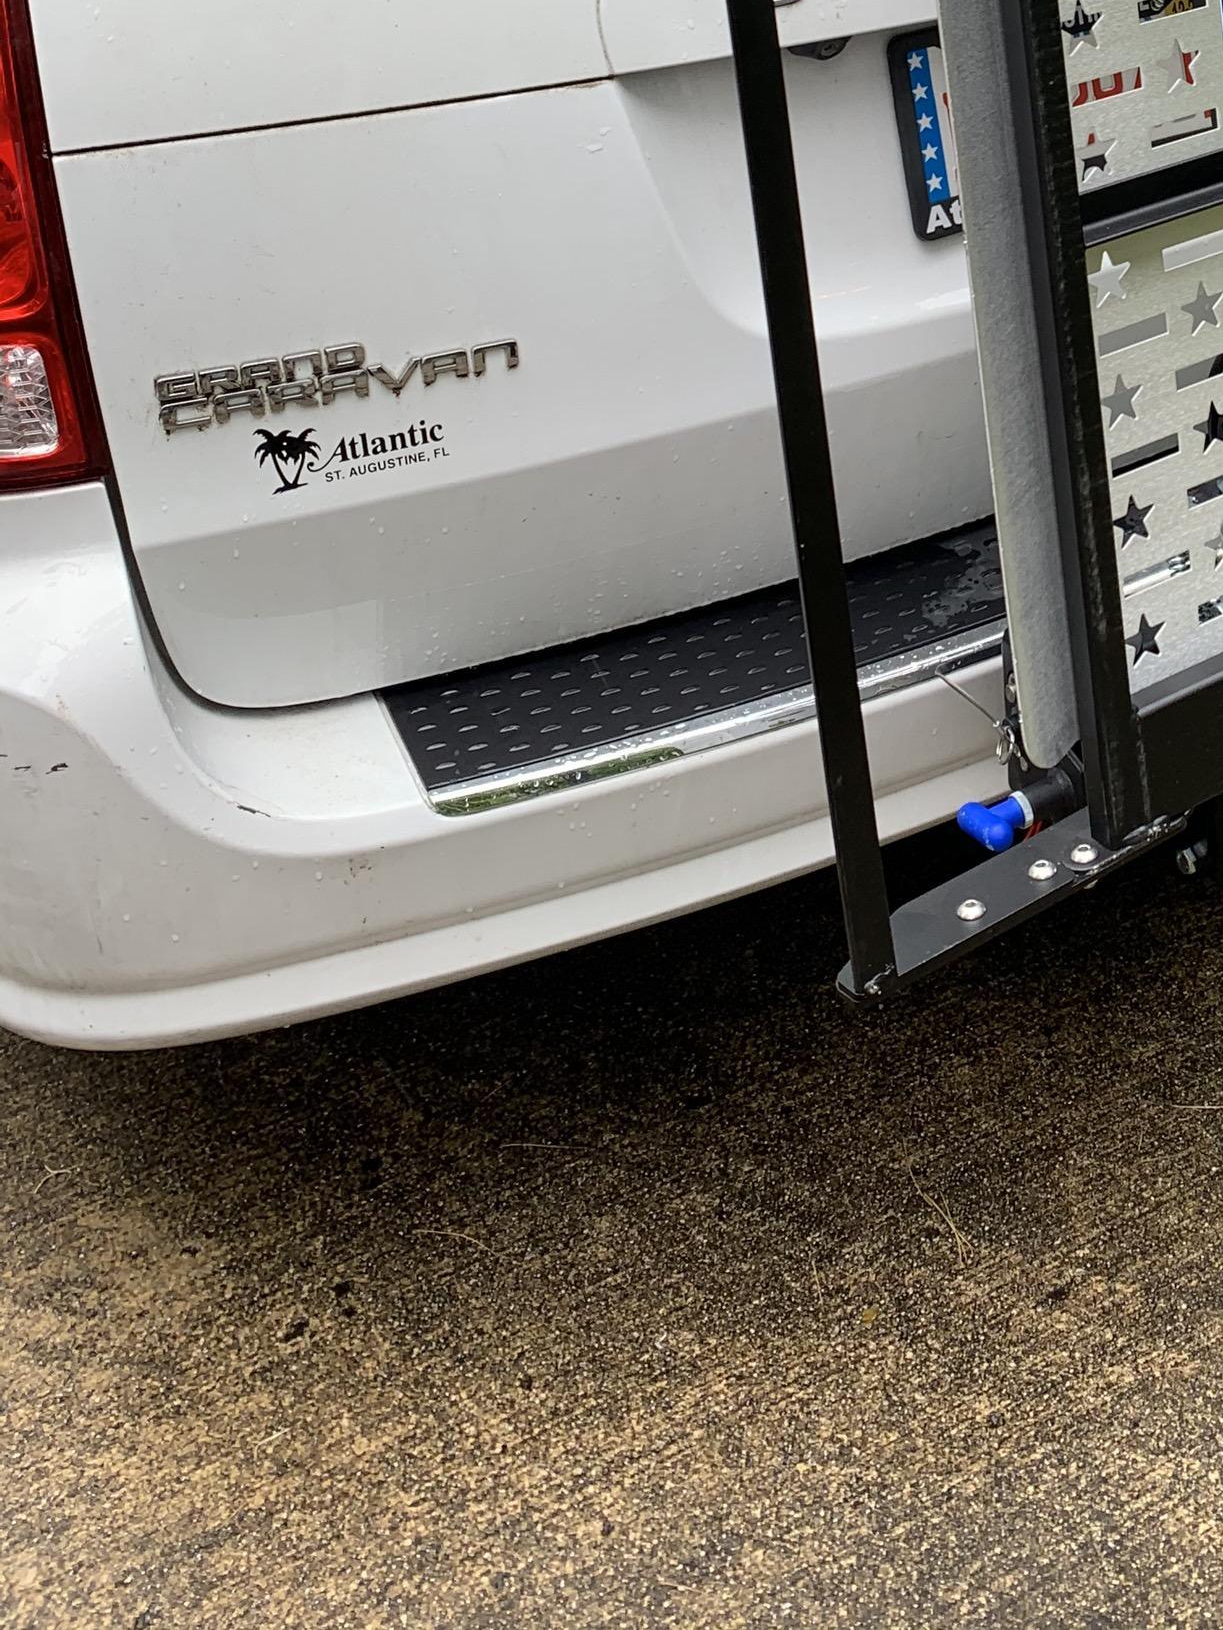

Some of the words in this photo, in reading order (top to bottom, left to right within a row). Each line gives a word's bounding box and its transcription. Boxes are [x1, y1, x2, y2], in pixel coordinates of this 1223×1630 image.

[154, 341, 367, 402] GRAND
[158, 337, 520, 434] CARAVAN
[306, 419, 445, 473] Atlantic
[324, 469, 346, 483] ST.
[349, 451, 431, 478] AUGUSTINE,
[433, 447, 450, 459] FL
